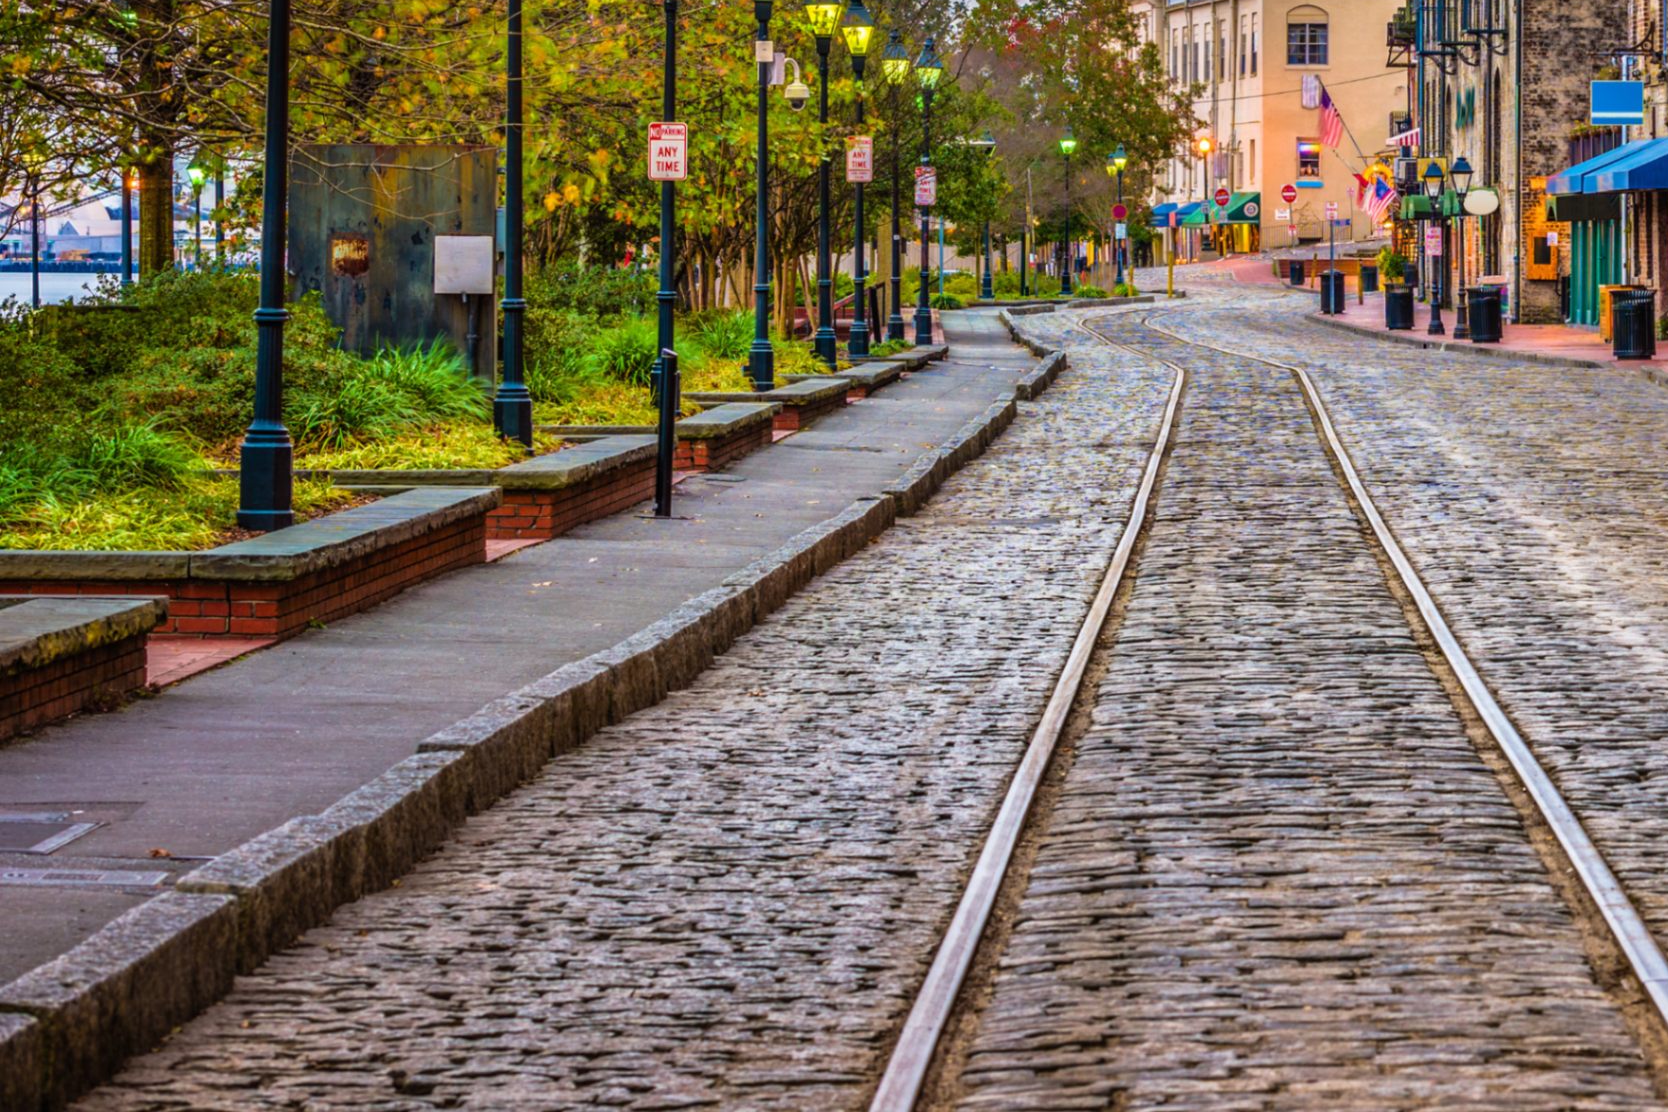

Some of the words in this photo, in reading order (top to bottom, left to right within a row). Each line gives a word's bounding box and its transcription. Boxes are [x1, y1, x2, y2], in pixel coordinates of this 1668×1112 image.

[651, 128, 662, 138] NO
[657, 147, 678, 157] ANY
[656, 161, 680, 172] TIME
